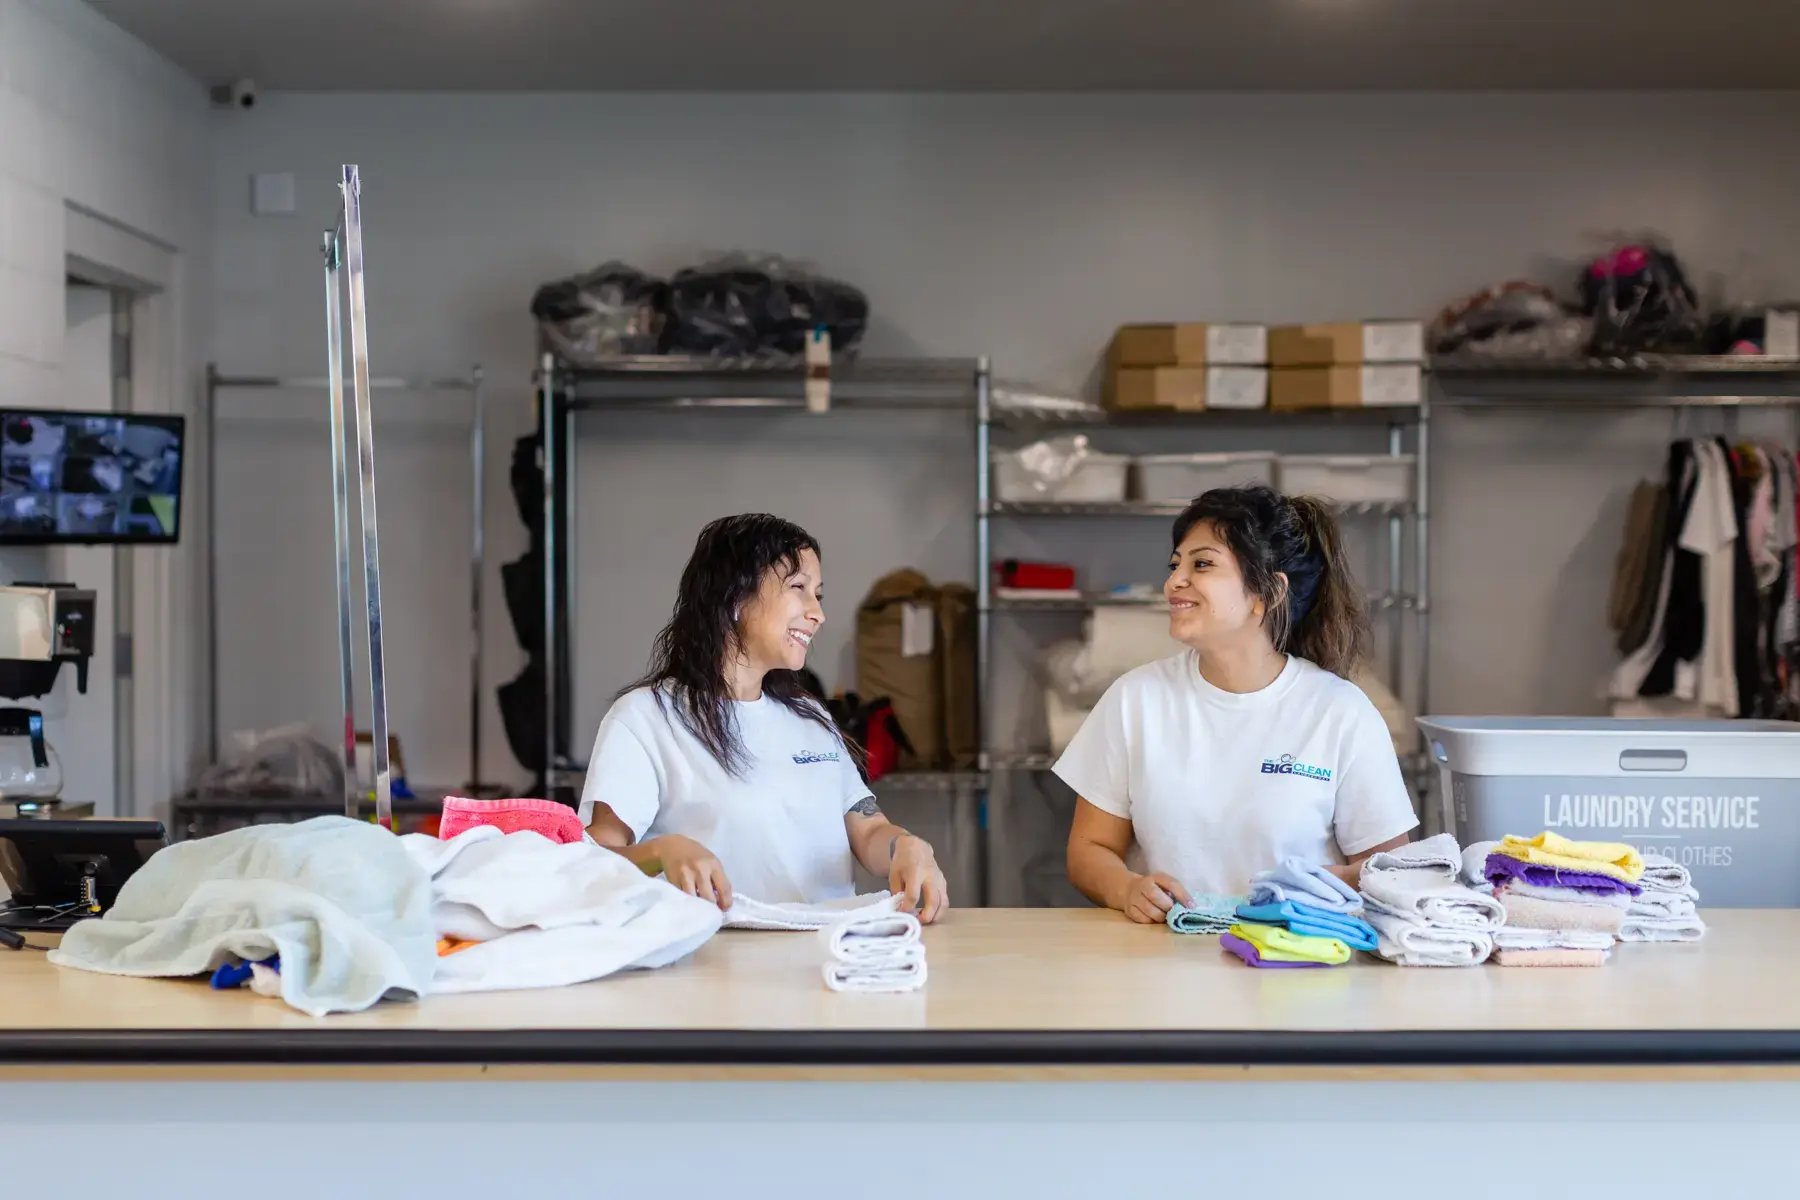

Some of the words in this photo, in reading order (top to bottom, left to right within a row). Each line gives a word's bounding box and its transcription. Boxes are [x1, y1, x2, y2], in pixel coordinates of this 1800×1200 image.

[792, 756, 820, 764] BIG
[1261, 763, 1292, 774] BIG
[1293, 763, 1332, 777] CLEAN
[1543, 794, 1655, 828] LAUNDRY
[1661, 796, 1760, 829] SERVICE
